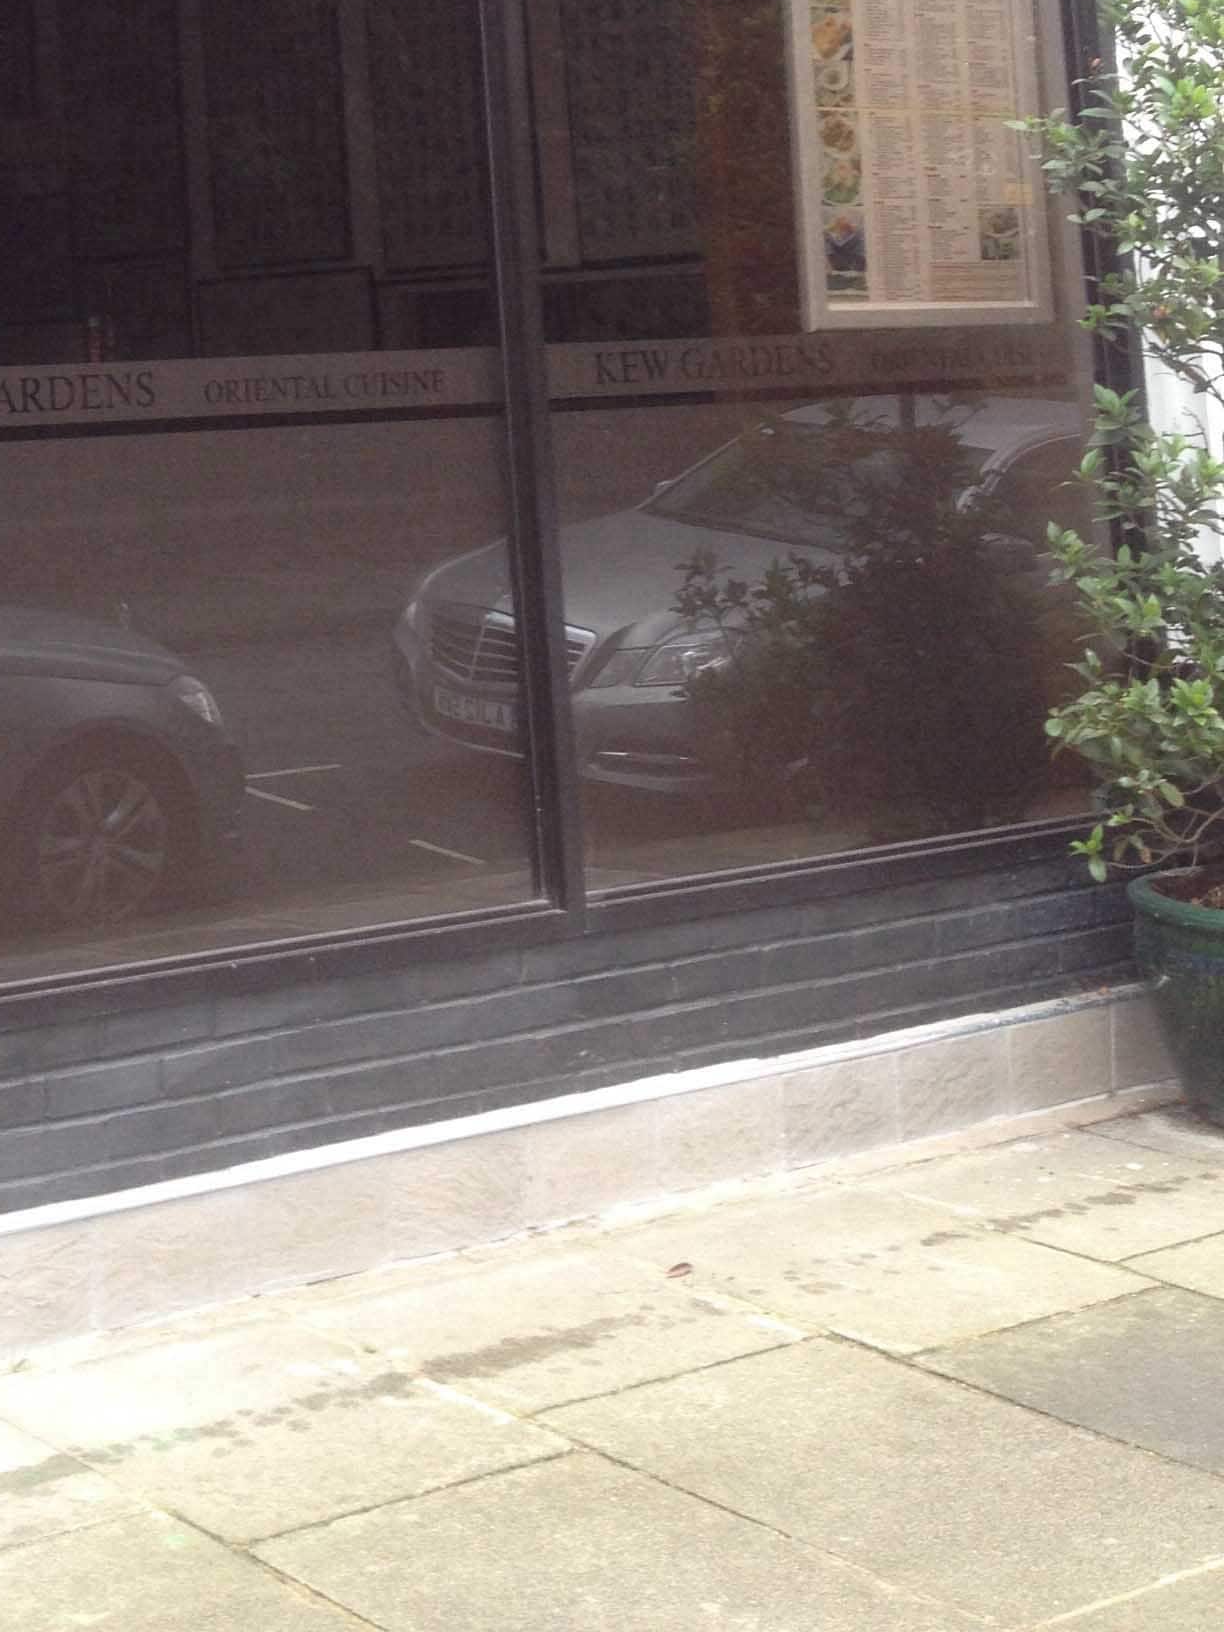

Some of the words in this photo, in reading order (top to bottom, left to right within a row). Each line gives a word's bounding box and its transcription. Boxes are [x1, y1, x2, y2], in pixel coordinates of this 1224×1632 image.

[594, 349, 668, 385] KEW
[679, 342, 834, 379] GARDENS
[204, 375, 338, 403] ORIENTAL
[343, 368, 448, 398] CUISINE
